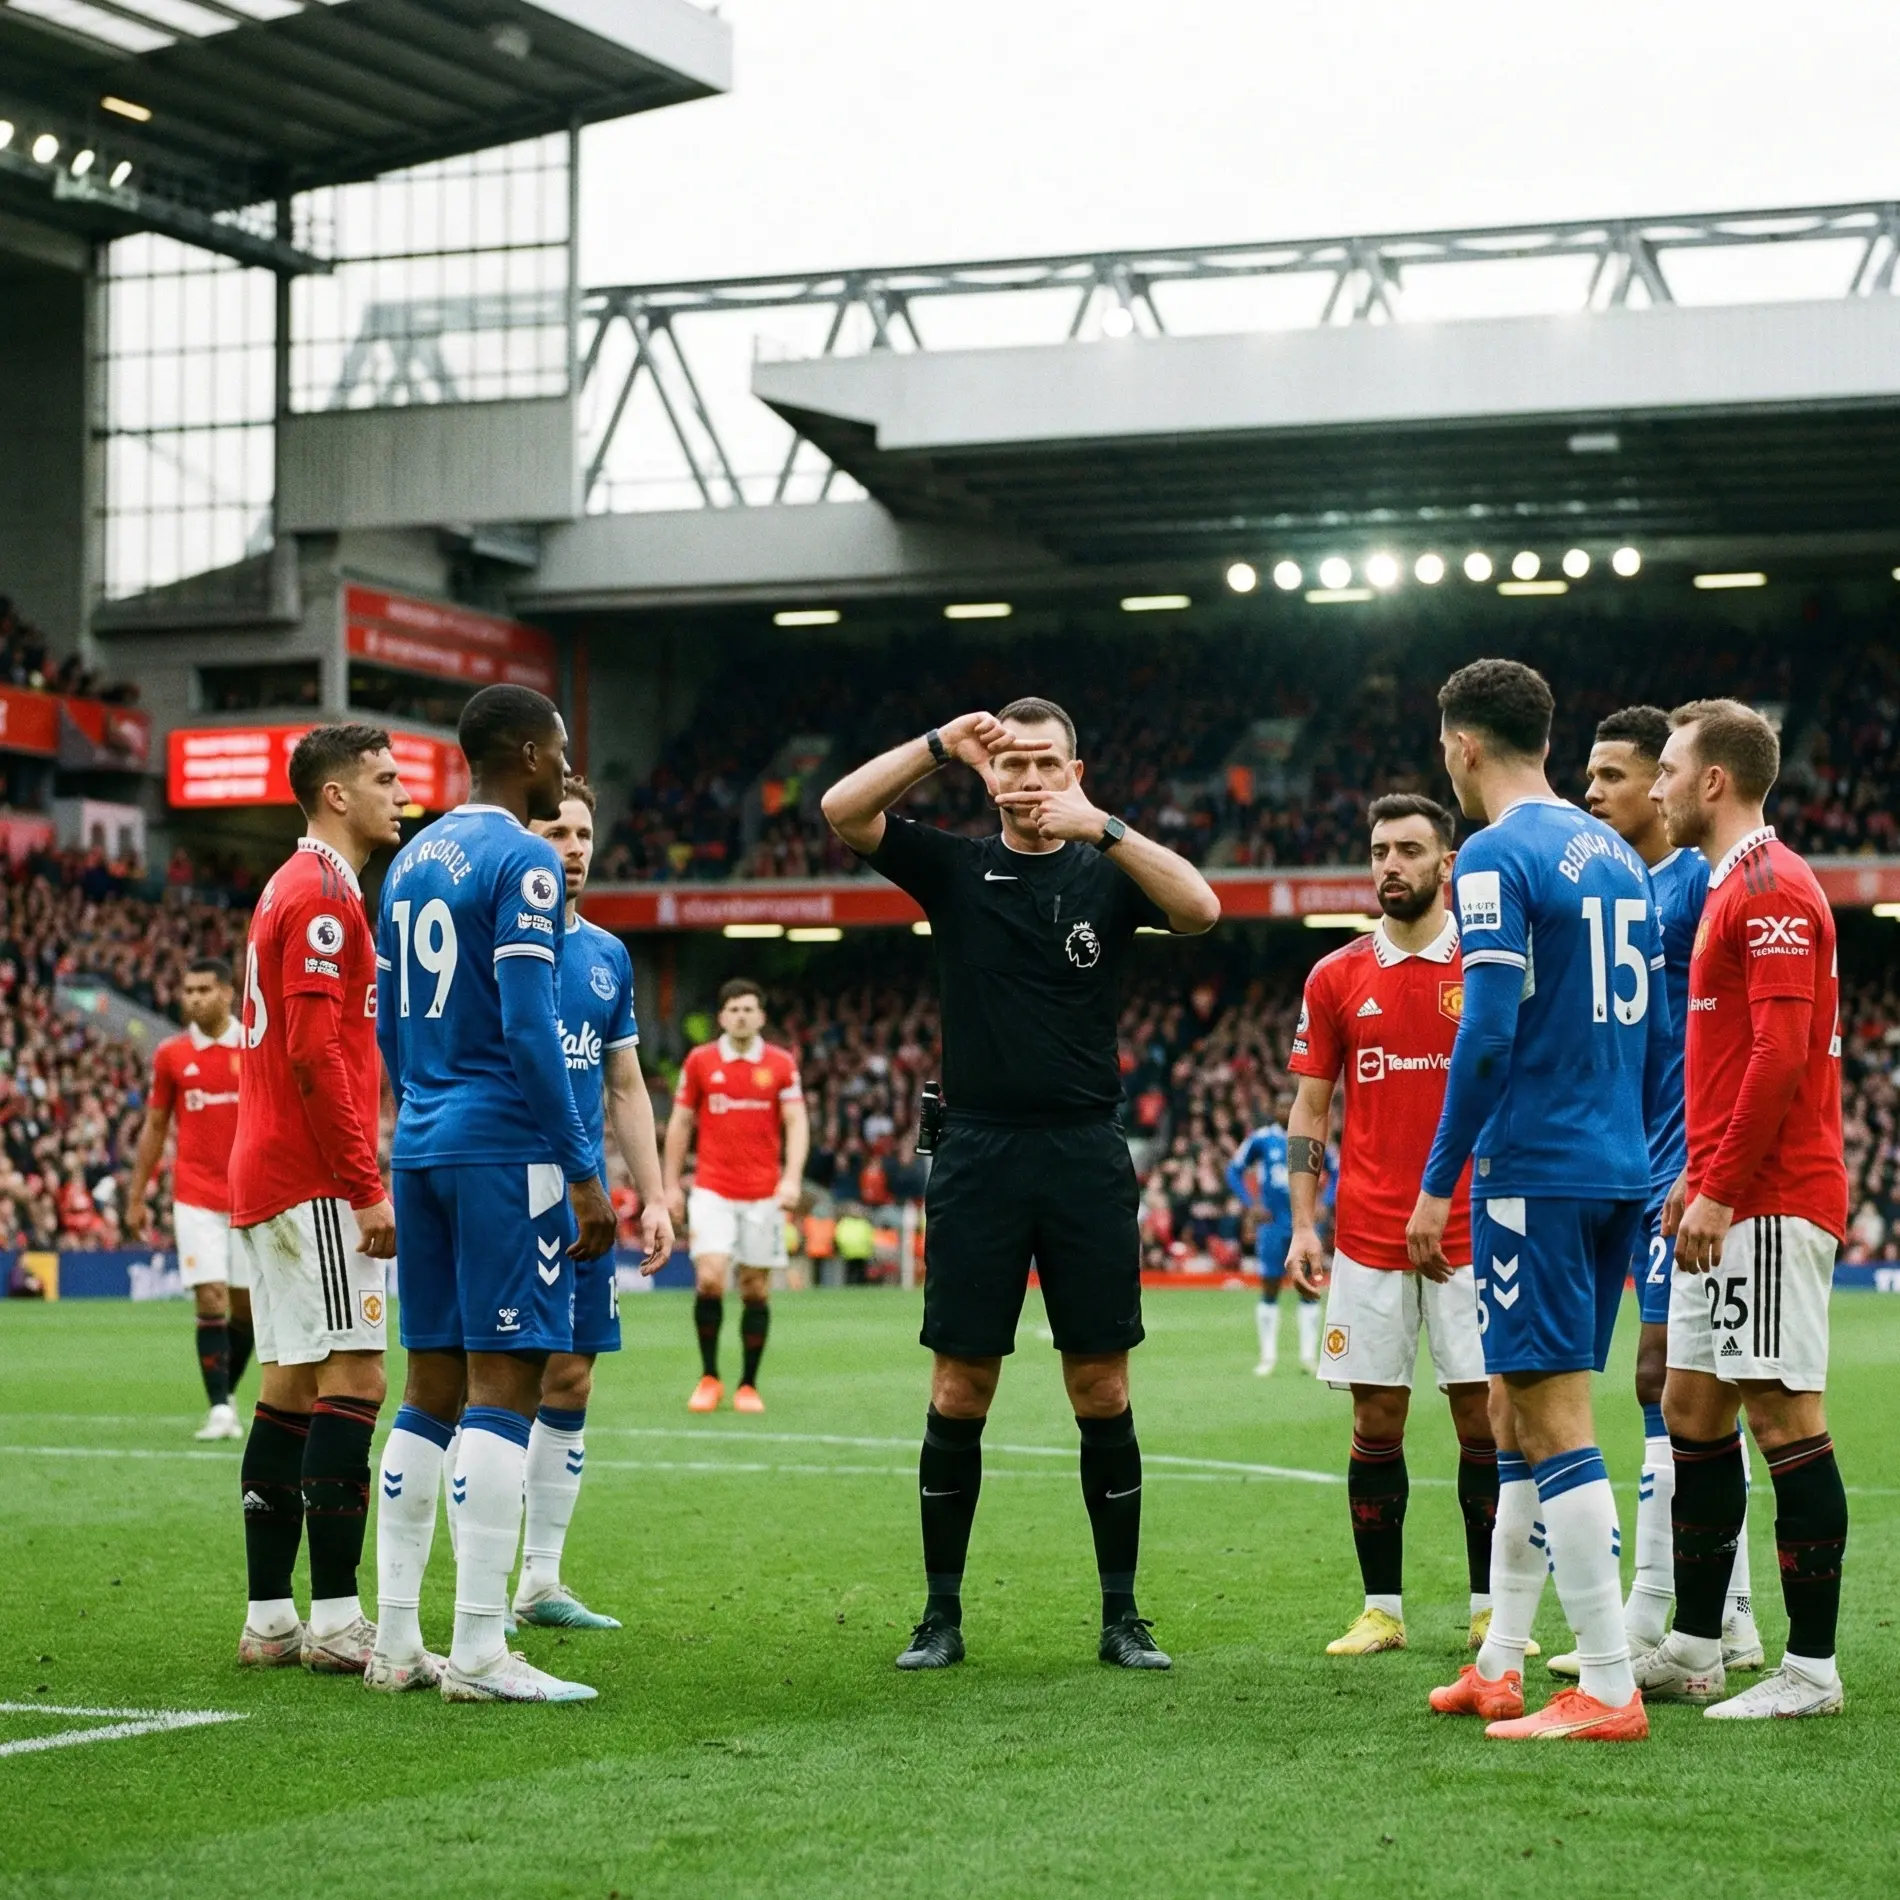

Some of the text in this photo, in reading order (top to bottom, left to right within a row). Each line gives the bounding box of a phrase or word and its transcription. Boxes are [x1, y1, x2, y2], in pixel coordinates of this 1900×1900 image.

[392, 898, 458, 1019] 19
[1582, 897, 1649, 1026] 15
[1746, 916, 1810, 947] DXC
[1704, 1277, 1749, 1331] 25
